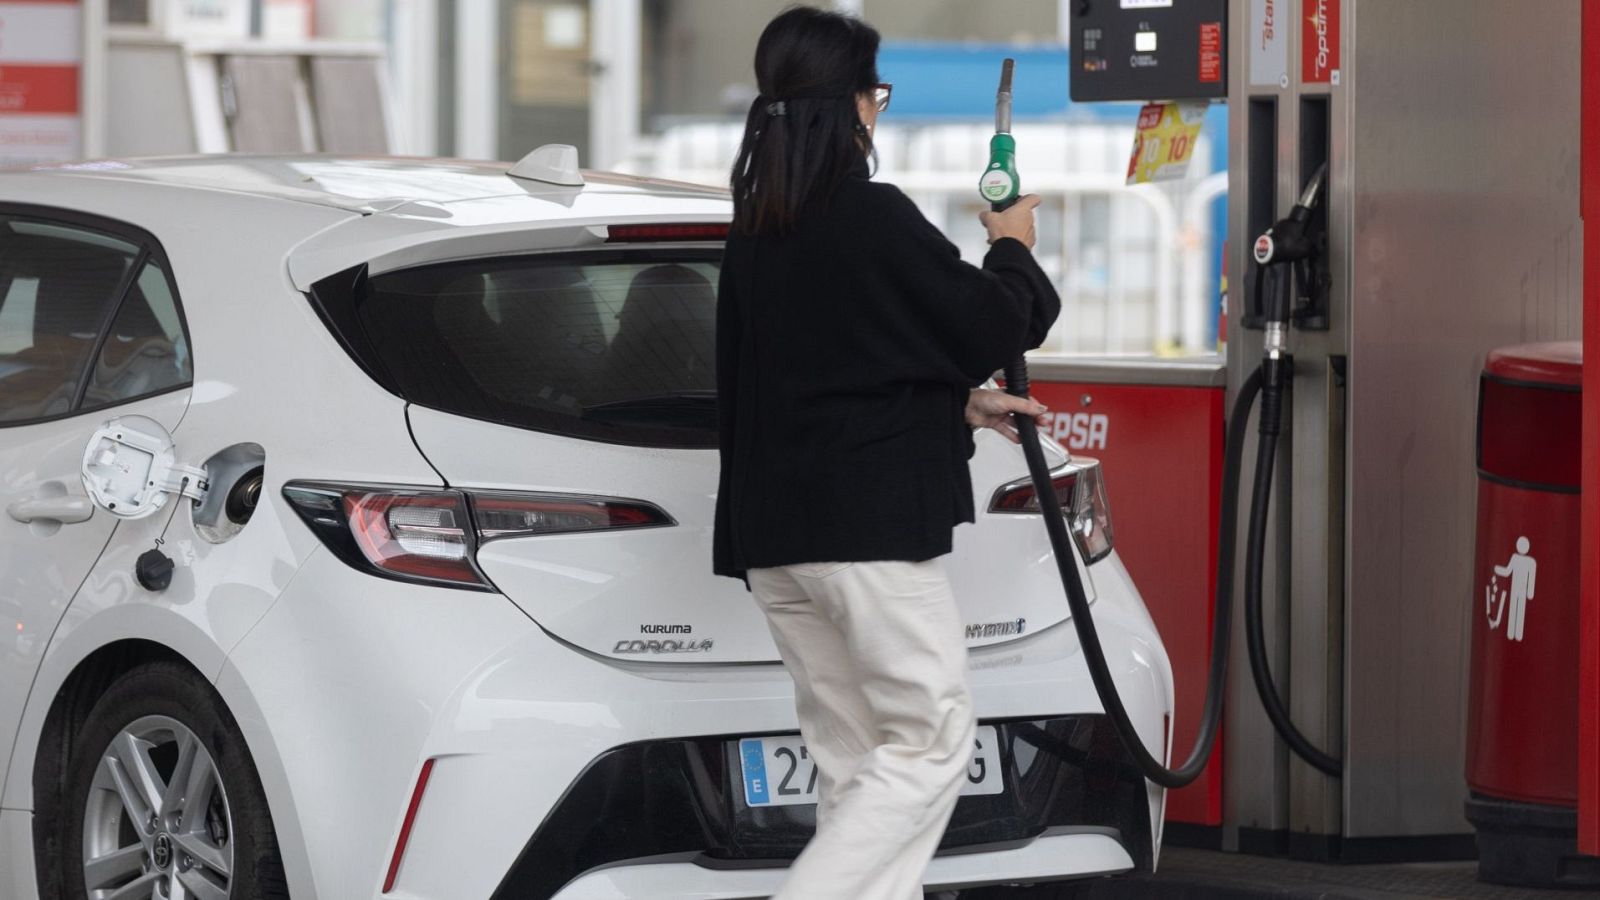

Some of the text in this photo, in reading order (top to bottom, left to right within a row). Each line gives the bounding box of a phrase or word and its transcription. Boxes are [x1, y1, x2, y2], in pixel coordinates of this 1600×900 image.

[1037, 412, 1108, 450] EPSA
[640, 624, 692, 634] KURUMA
[612, 638, 714, 654] COROLLA
[753, 779, 763, 793] E
